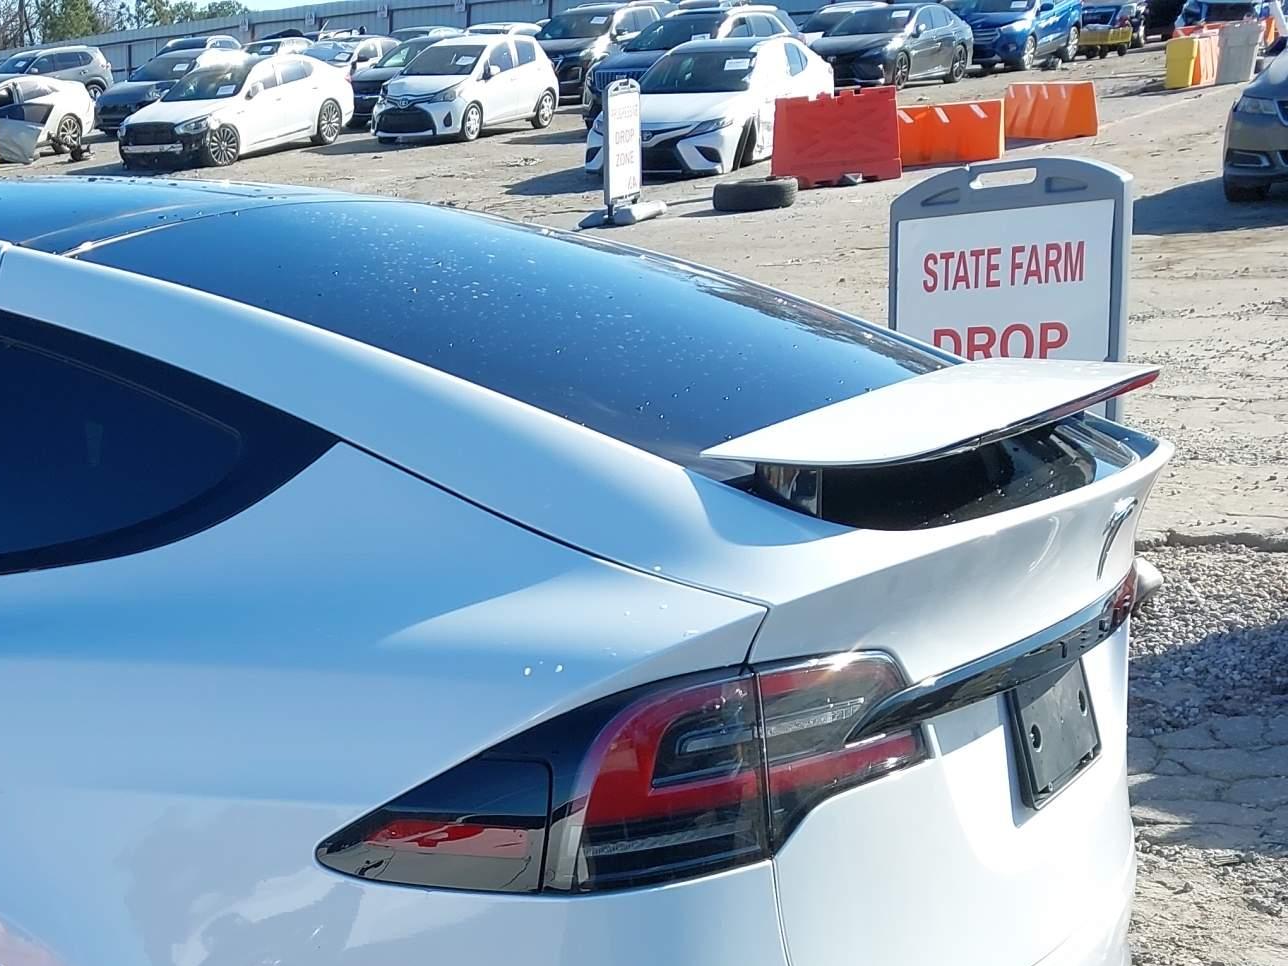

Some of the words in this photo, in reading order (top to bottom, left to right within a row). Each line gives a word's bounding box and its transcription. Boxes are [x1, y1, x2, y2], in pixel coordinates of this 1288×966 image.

[615, 150, 634, 167] ZONE
[922, 247, 1002, 293] STATE
[1010, 240, 1085, 286] FARM
[933, 321, 1069, 361] DROP
